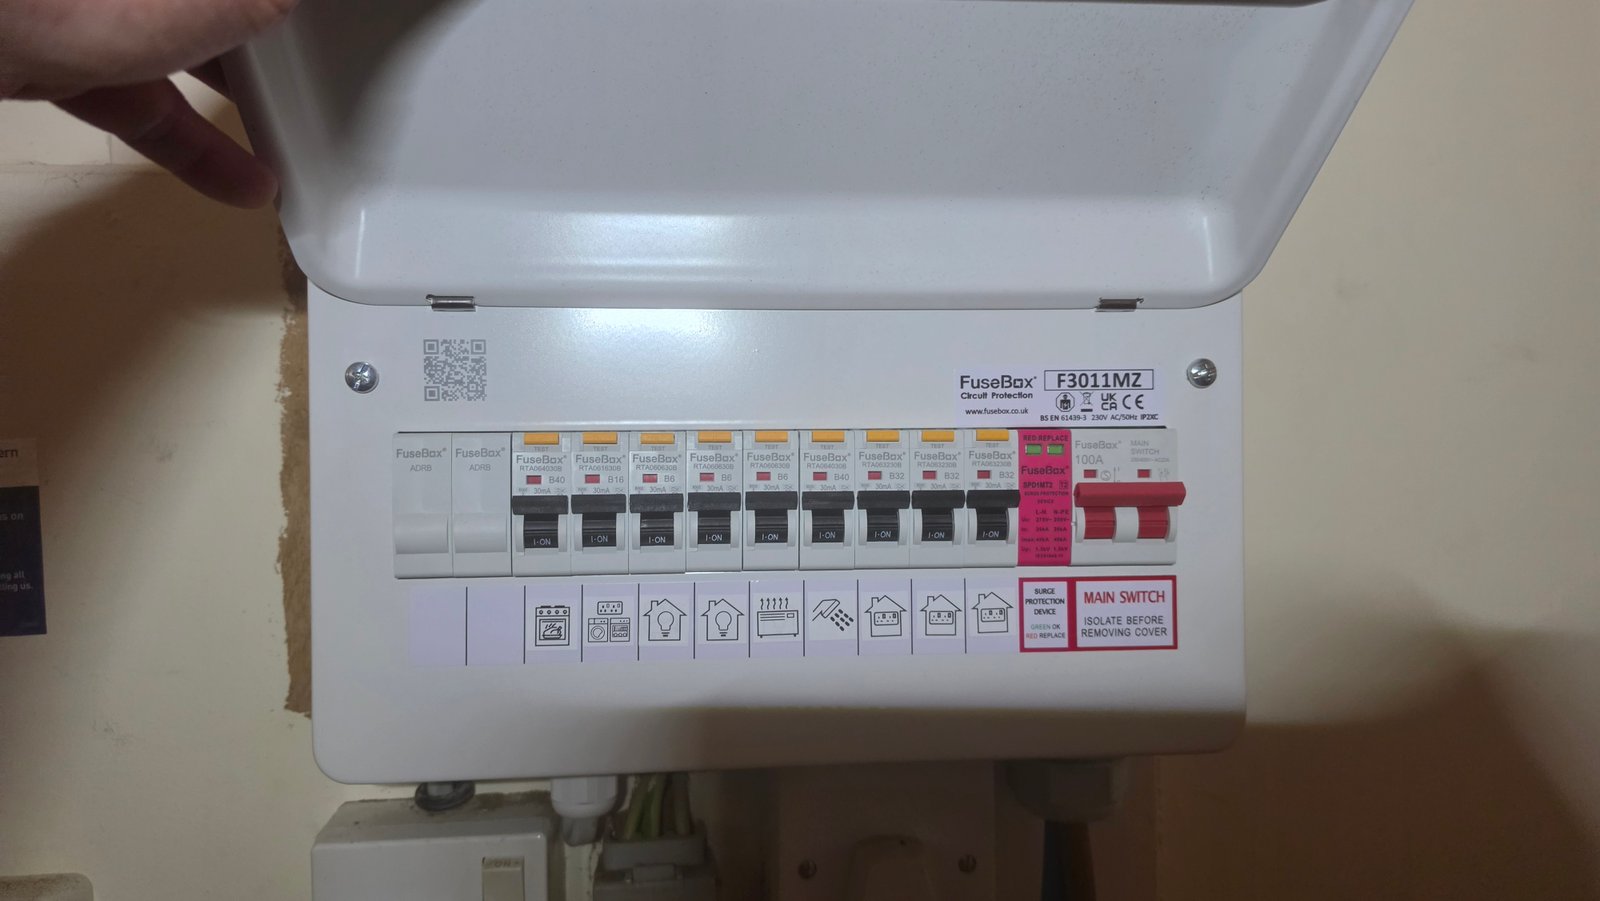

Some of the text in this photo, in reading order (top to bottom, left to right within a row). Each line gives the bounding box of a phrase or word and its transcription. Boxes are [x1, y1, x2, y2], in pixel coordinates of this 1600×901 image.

[1057, 372, 1142, 388] F3011MZ
[961, 392, 1033, 400] Circuit Protection
[965, 407, 1028, 415] www.fusebox.co.uk
[1075, 455, 1104, 465] 100A
[664, 475, 675, 483] B6
[778, 473, 788, 481] B6
[834, 473, 849, 481] B40
[889, 472, 905, 480] B32
[944, 472, 960, 480] B32
[999, 471, 1015, 479] B32
[549, 476, 565, 484] B40
[1084, 590, 1165, 604] MAIN SWITCH
[1084, 615, 1163, 625] ISOLATE BEFORE
[1081, 627, 1167, 637] REMOVING COVER
